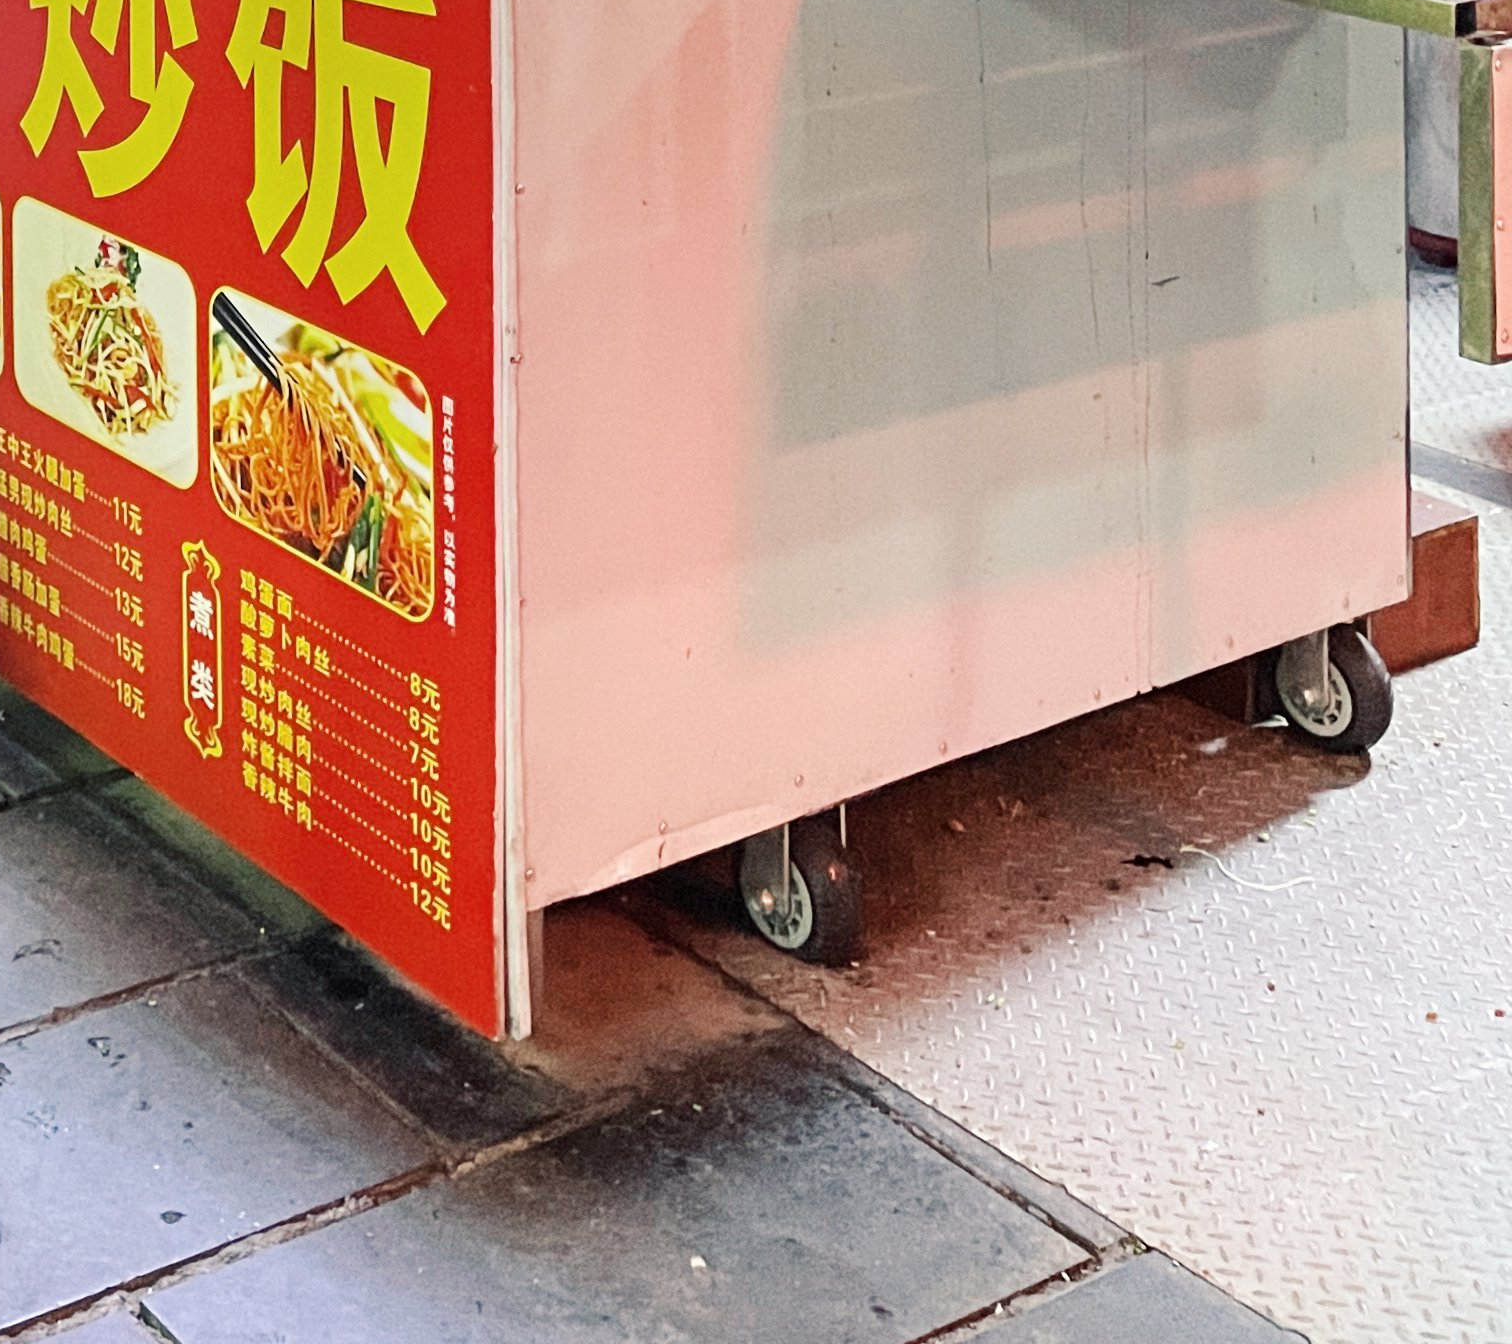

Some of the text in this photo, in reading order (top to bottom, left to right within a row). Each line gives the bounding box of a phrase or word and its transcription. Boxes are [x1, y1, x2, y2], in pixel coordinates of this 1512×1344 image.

[113, 496, 143, 536] 11元
[114, 542, 144, 582] 12元
[115, 587, 144, 628] 13元
[116, 632, 145, 675] 15元
[189, 590, 216, 710] 煮类
[240, 568, 441, 712] 鸡蛋面 8元
[240, 599, 440, 746] 酸萝卜肉丝 8元
[116, 678, 146, 720] 18元
[240, 664, 451, 824] 现炒肉丝 10元
[241, 632, 440, 781] 素菜 7元
[241, 696, 451, 859] 现炒腊肉 10元
[241, 728, 451, 895] 炸酱拌面 10元
[242, 760, 451, 931] 香辣牛肉 12元
